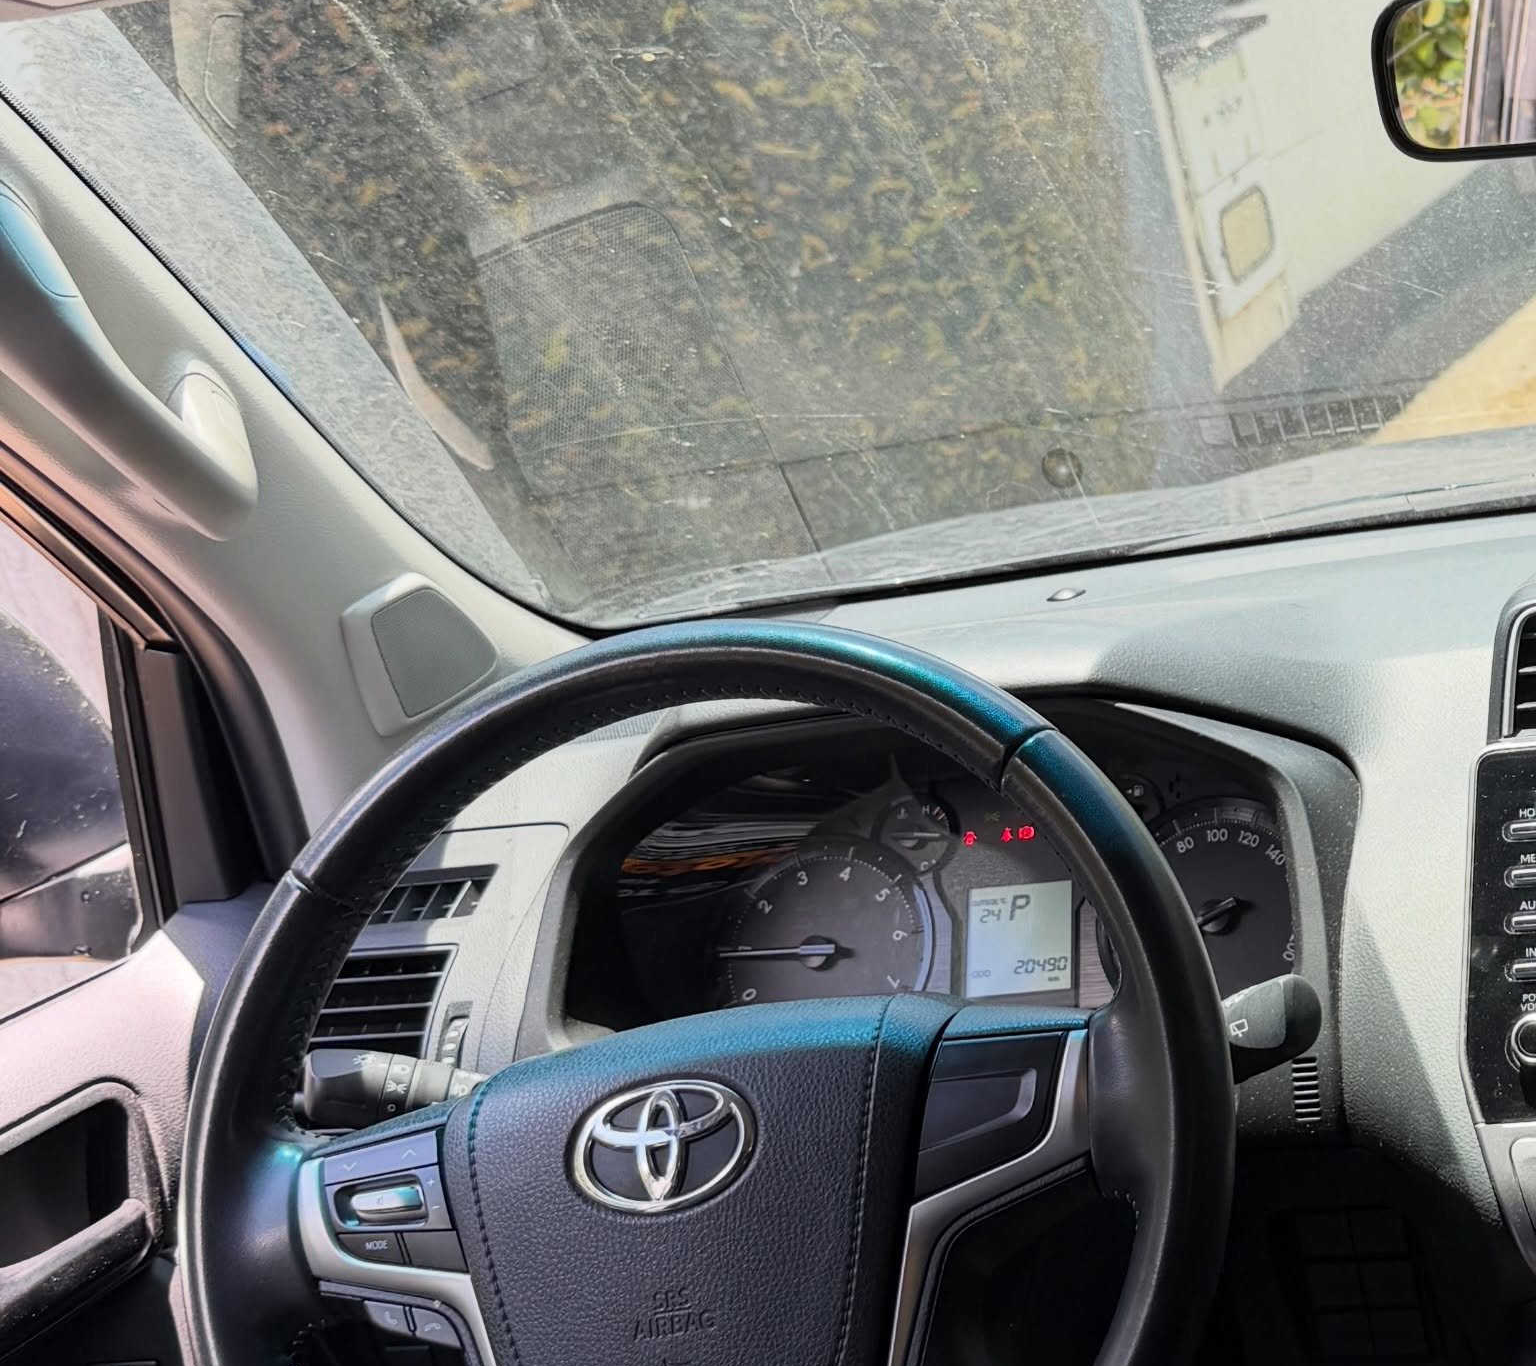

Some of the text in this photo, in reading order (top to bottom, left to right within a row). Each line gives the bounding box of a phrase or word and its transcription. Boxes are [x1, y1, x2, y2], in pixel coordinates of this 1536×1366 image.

[1206, 828, 1229, 842] 100
[1237, 830, 1260, 848] 120
[1176, 836, 1195, 853] 80
[1264, 844, 1286, 866] 140
[797, 870, 809, 885] 3
[839, 867, 851, 881] 4
[875, 888, 890, 902] 5
[758, 900, 773, 915] 2
[1009, 894, 1031, 921] P
[980, 908, 1002, 924] 24
[892, 930, 908, 941] 6
[1013, 955, 1069, 975] 20490
[887, 975, 900, 989] 7
[742, 988, 757, 1001] 0
[365, 1239, 388, 1250] MODE
[633, 1309, 716, 1342] AIRBAG
